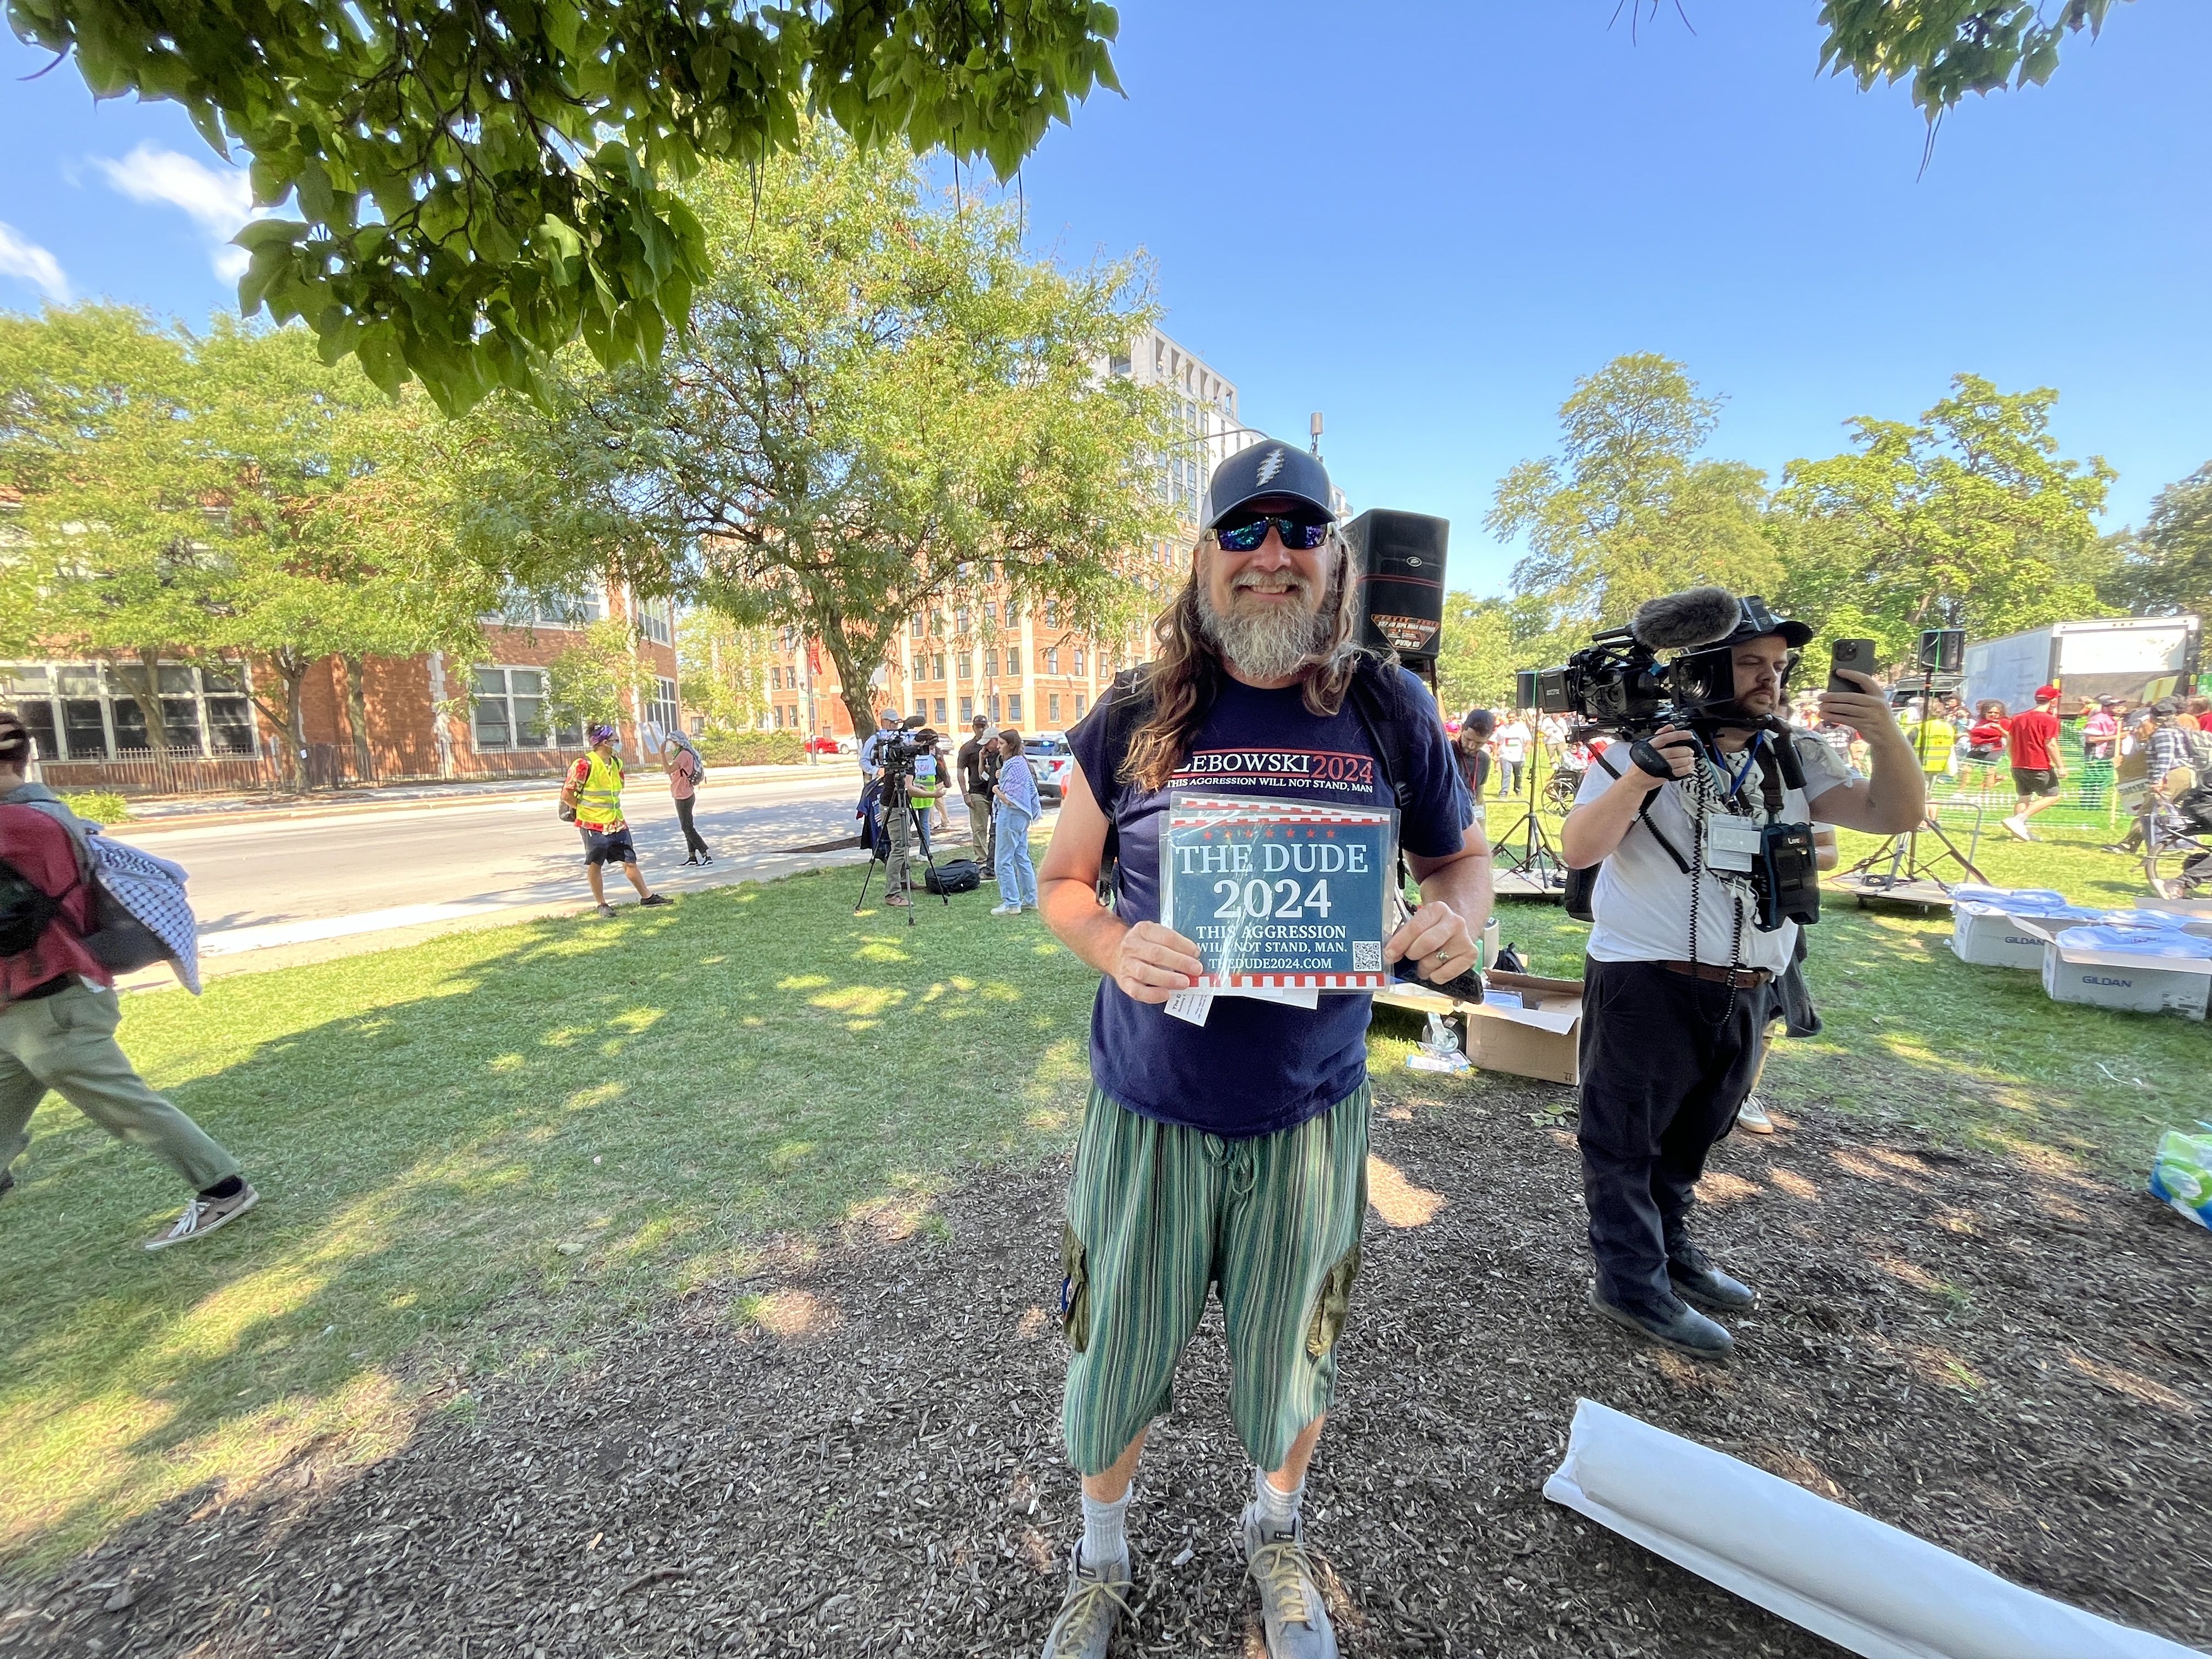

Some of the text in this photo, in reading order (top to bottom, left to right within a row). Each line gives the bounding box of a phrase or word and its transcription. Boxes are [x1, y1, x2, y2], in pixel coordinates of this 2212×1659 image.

[1311, 755, 1373, 784] 2024
[1167, 777, 1373, 793] THIS AGGRESSION WILL NOT STAND, MAN
[1176, 843, 1369, 874] THE DUDE
[1213, 878, 1332, 918] 2024
[1196, 925, 1346, 939] THIS AGGRESSION
[1197, 941, 1347, 955] WIL NOT STAND, MAN.
[2005, 936, 2045, 946] GILDAN
[2082, 976, 2132, 988] GILDAN
